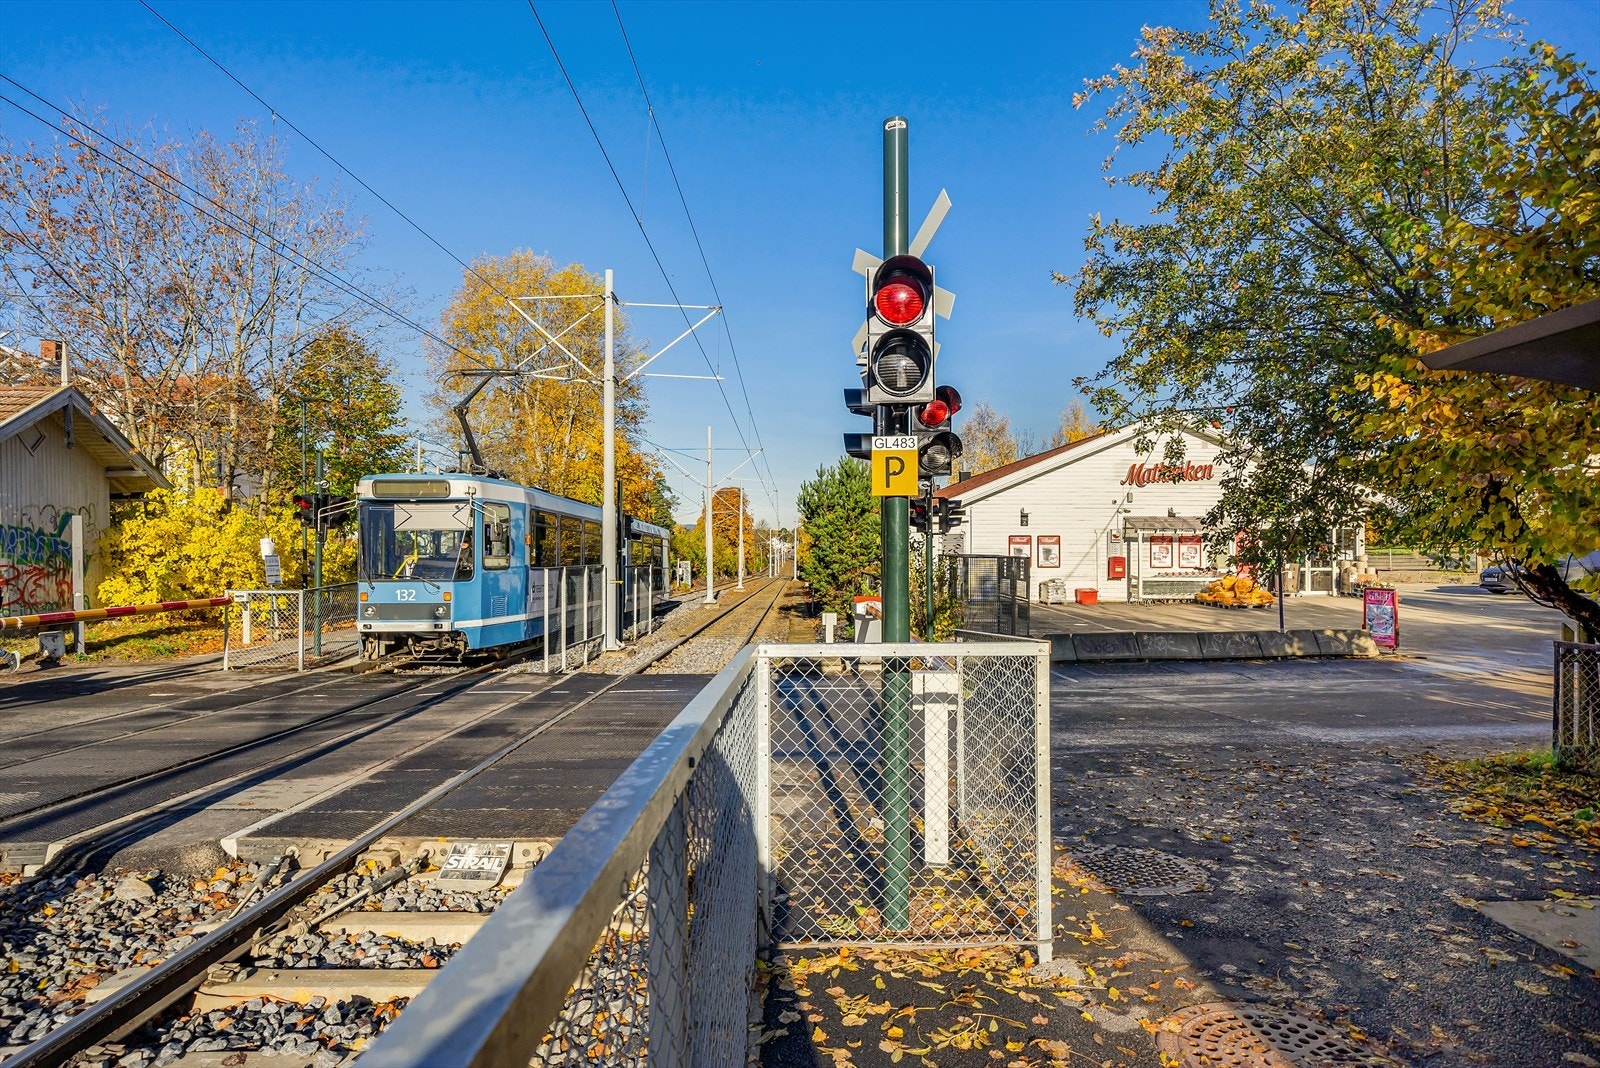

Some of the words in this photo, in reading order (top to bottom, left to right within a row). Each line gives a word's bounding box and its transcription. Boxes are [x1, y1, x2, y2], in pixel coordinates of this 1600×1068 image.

[874, 437, 916, 449] GL483
[885, 455, 905, 489] P
[1120, 460, 1214, 487] Matken
[395, 589, 416, 601] 132
[444, 855, 502, 870] STRAIL
